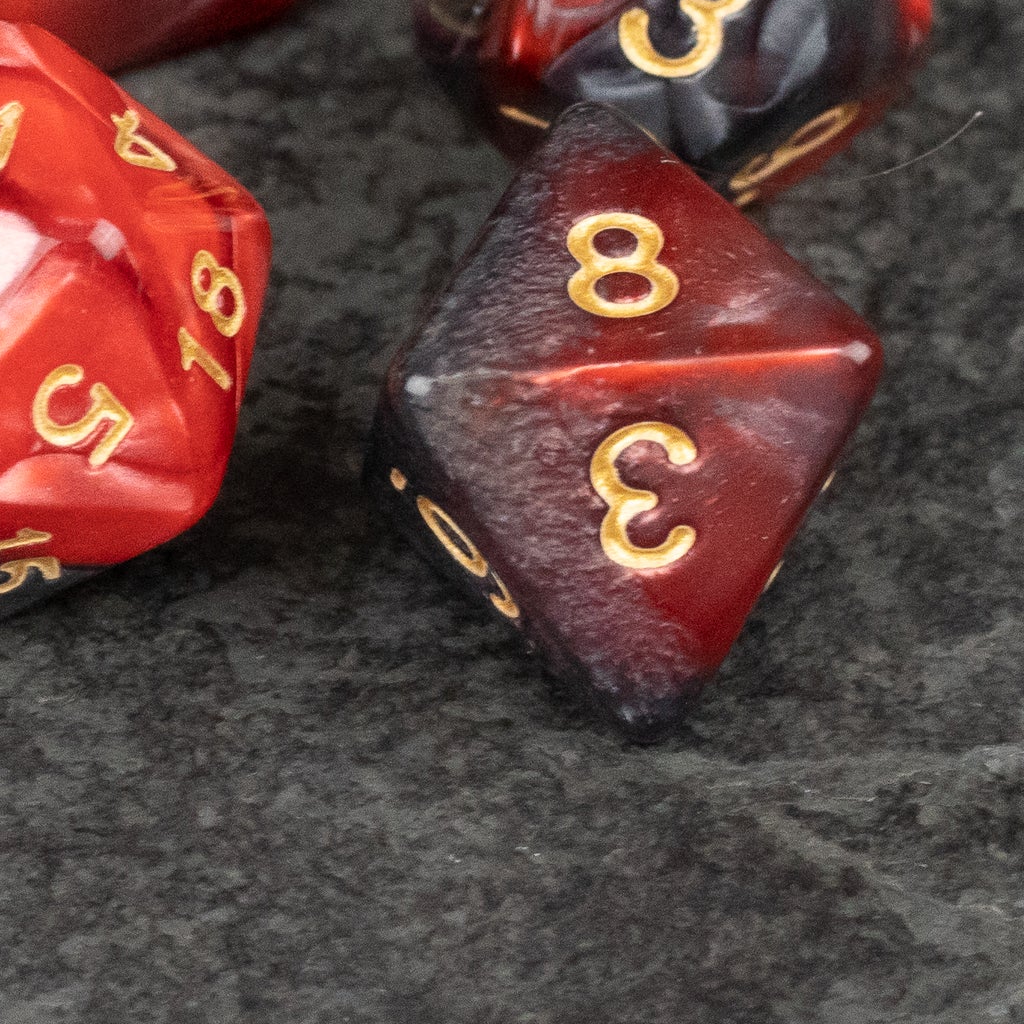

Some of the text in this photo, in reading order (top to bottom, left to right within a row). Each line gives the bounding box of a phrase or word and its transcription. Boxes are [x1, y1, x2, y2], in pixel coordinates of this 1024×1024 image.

[110, 107, 177, 173] 4
[566, 211, 680, 319] 8
[176, 248, 247, 393] 18
[32, 362, 135, 469] 5
[589, 420, 698, 571] 3
